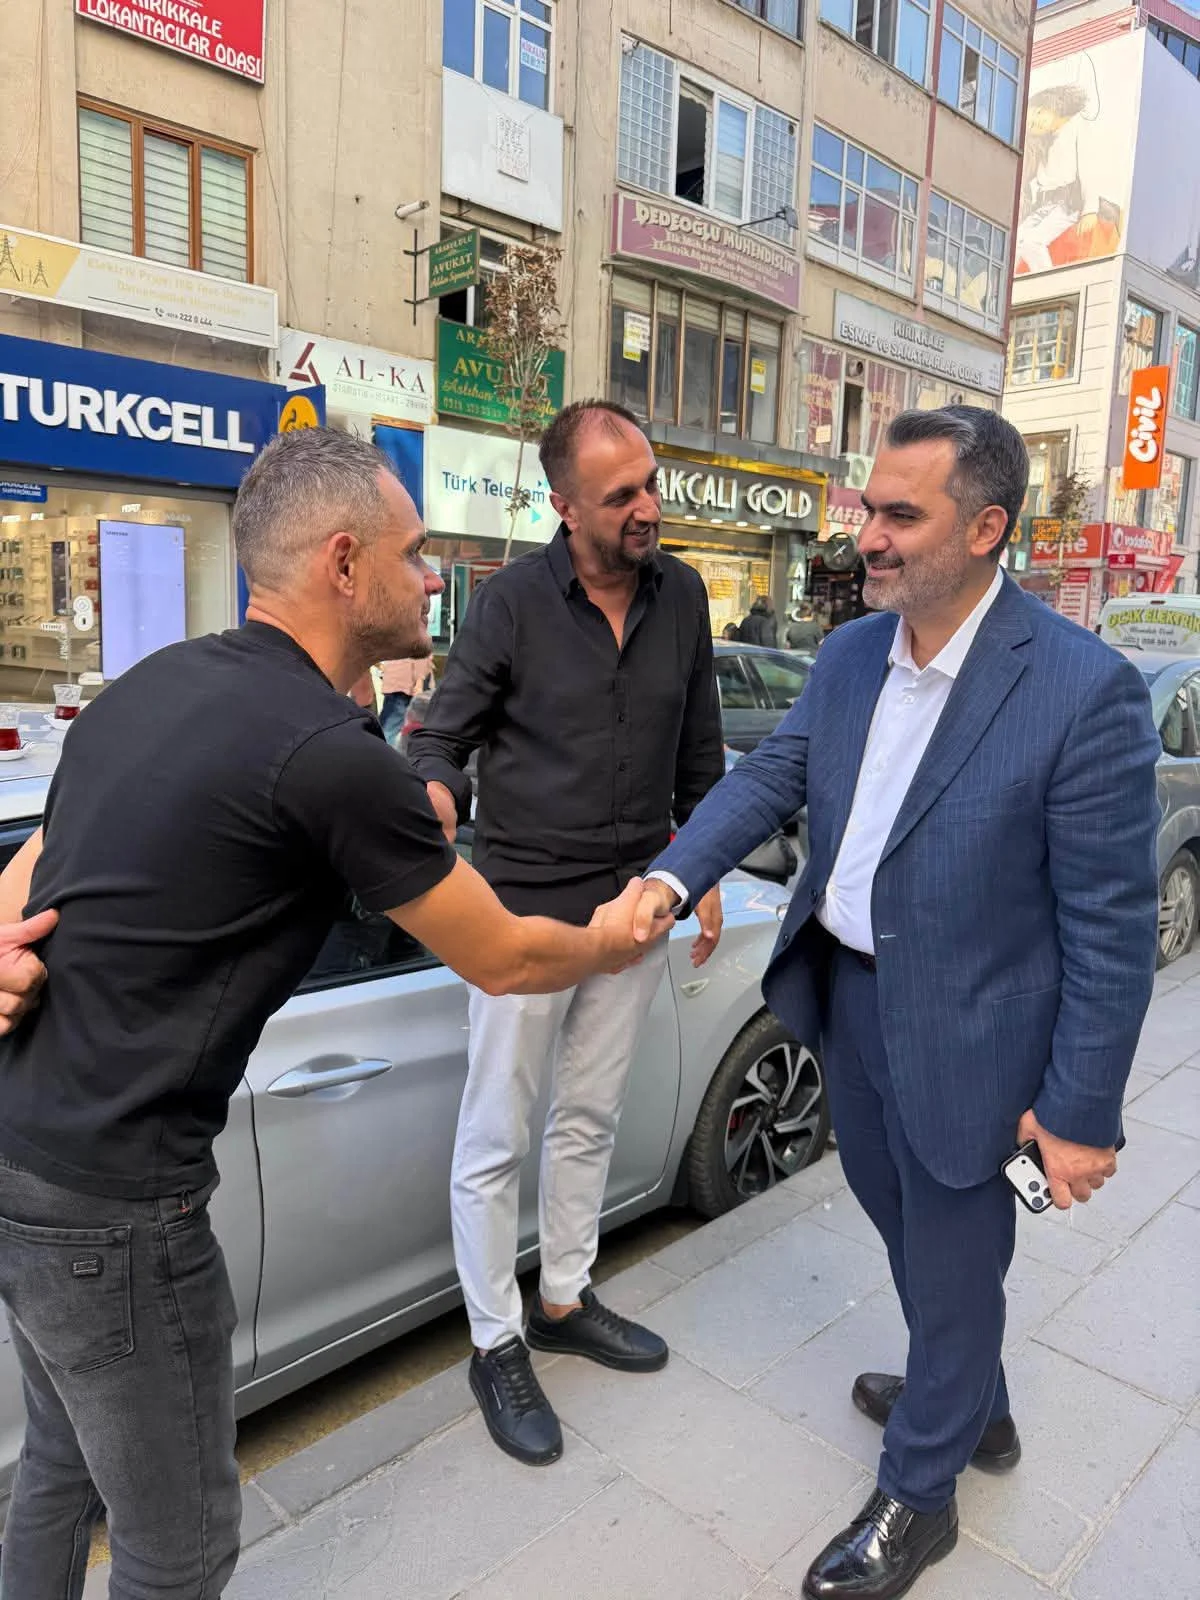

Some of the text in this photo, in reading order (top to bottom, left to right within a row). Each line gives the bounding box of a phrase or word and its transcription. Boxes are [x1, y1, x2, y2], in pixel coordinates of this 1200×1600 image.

[87, 0, 261, 77] LOKANTACILAR ODASI
[432, 252, 473, 277] AVUKAT
[336, 355, 425, 393] AL-KA
[0, 373, 255, 454] TURKCELL
[442, 471, 545, 503] Türk Telem
[656, 466, 812, 518] AKÇALI GOLD
